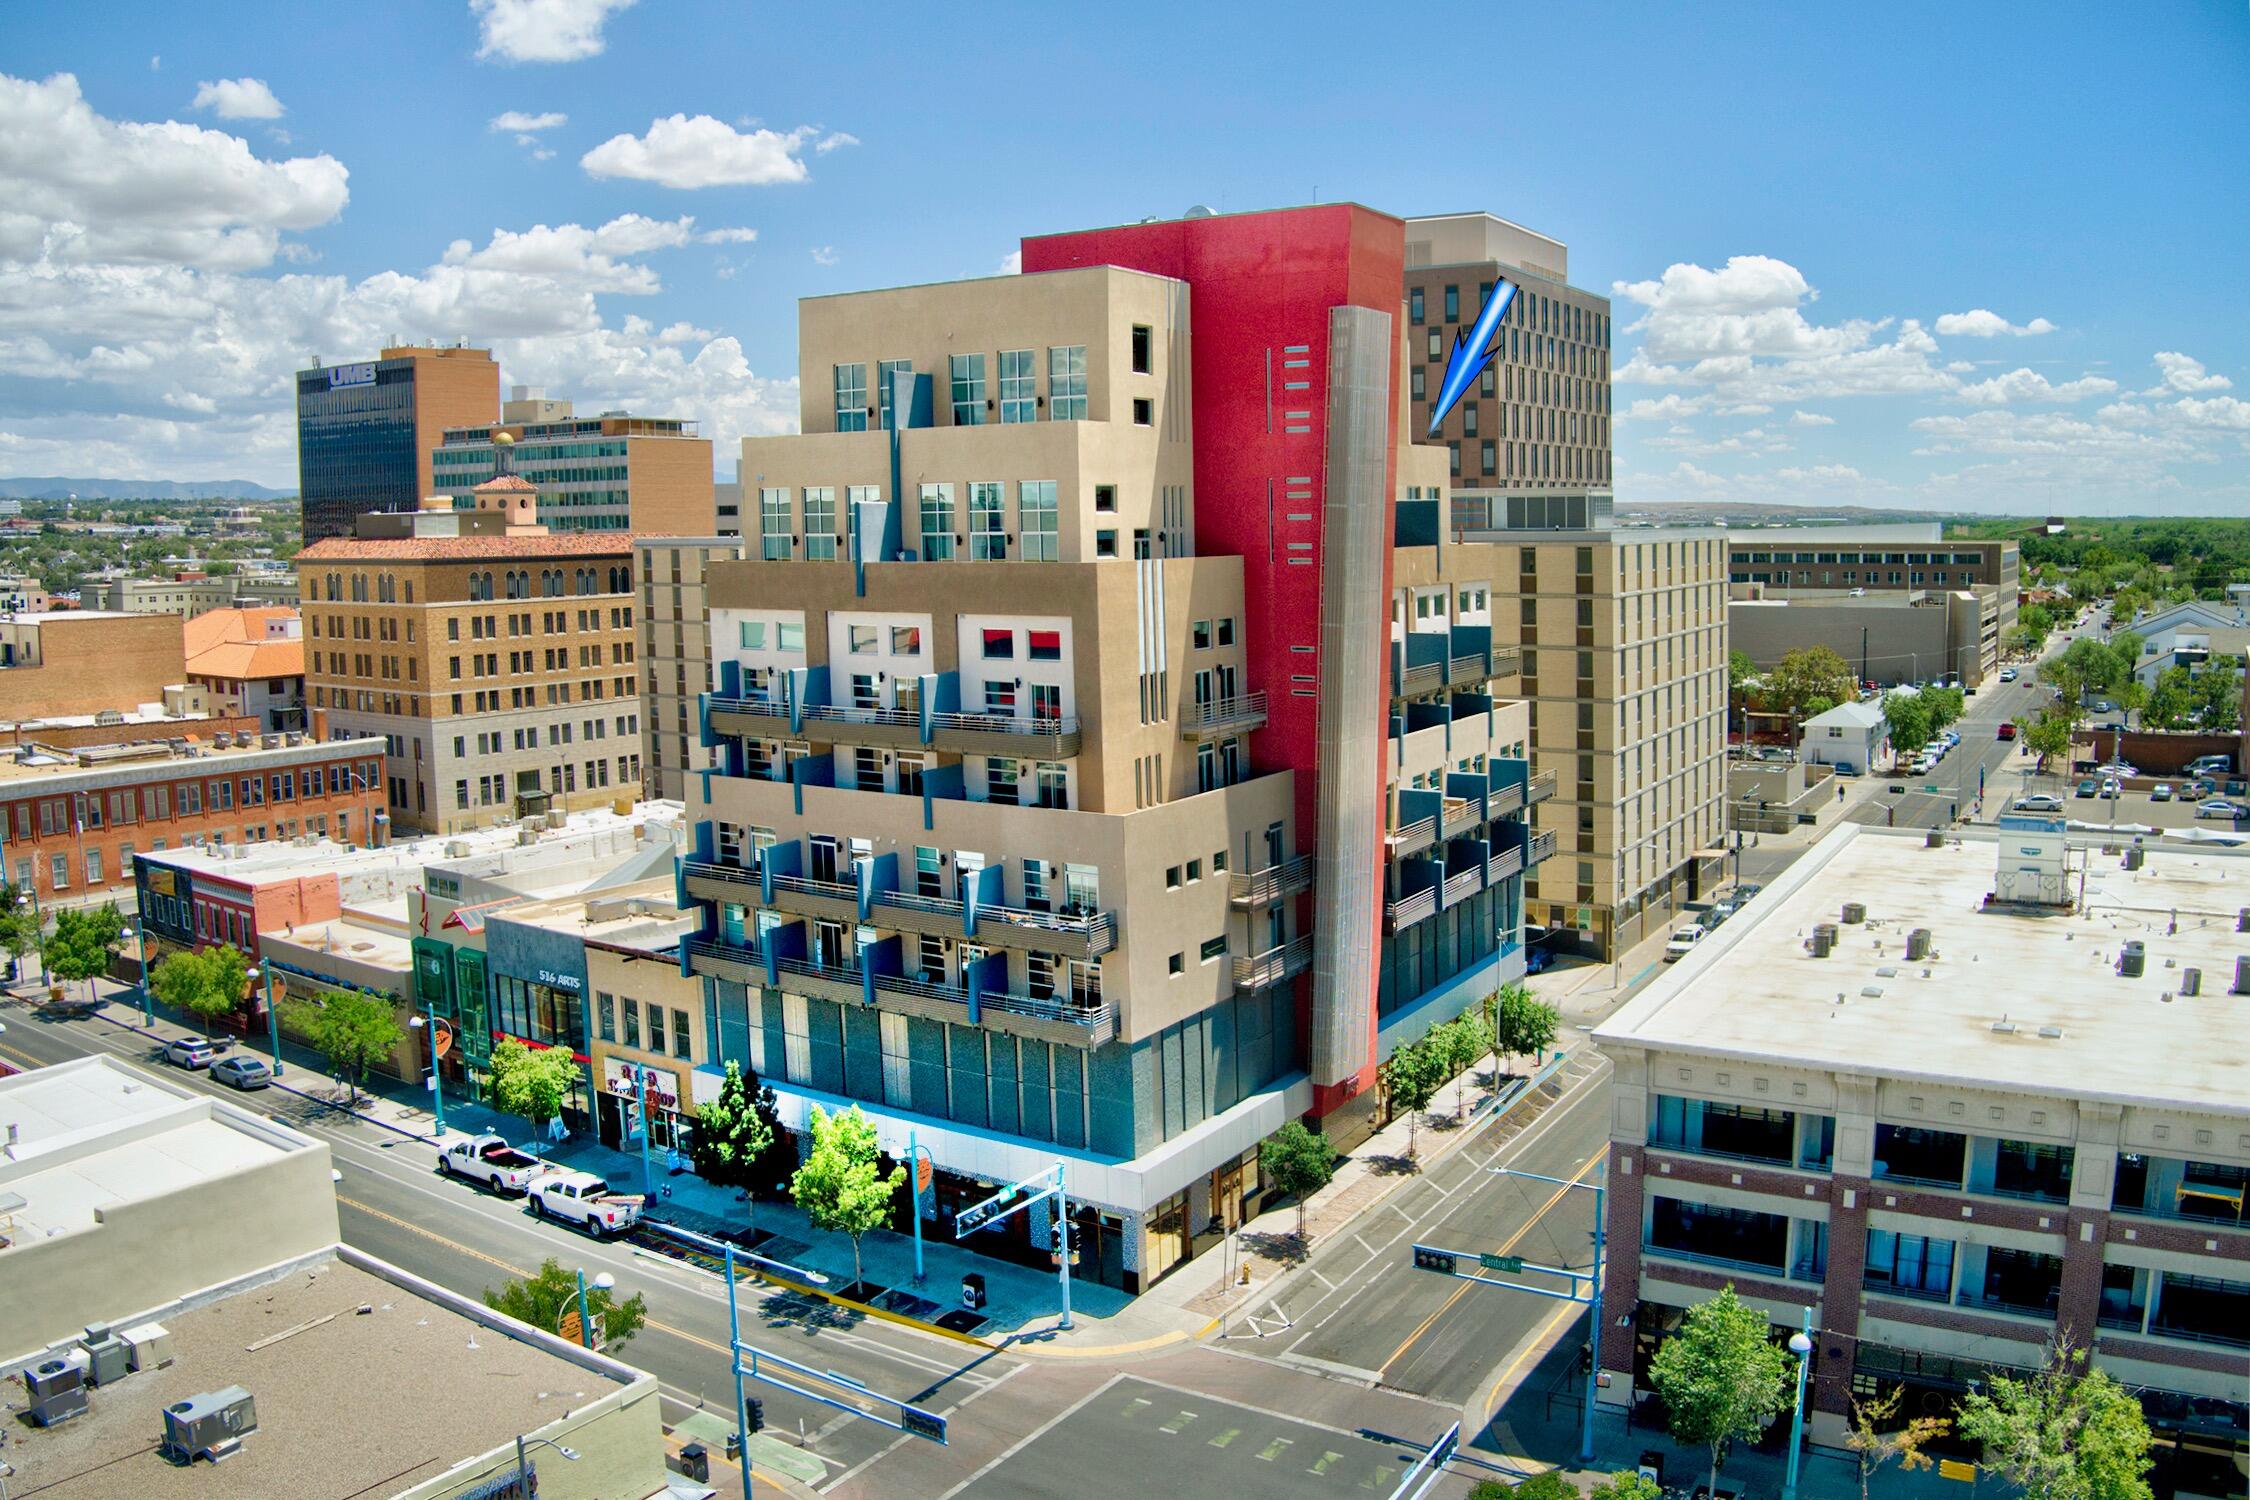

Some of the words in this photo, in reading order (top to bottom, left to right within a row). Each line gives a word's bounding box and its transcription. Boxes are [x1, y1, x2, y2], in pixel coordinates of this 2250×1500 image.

[328, 363, 377, 386] UMB
[539, 970, 556, 982] 516
[557, 974, 580, 988] ARTS
[1481, 1255, 1508, 1270] Central
